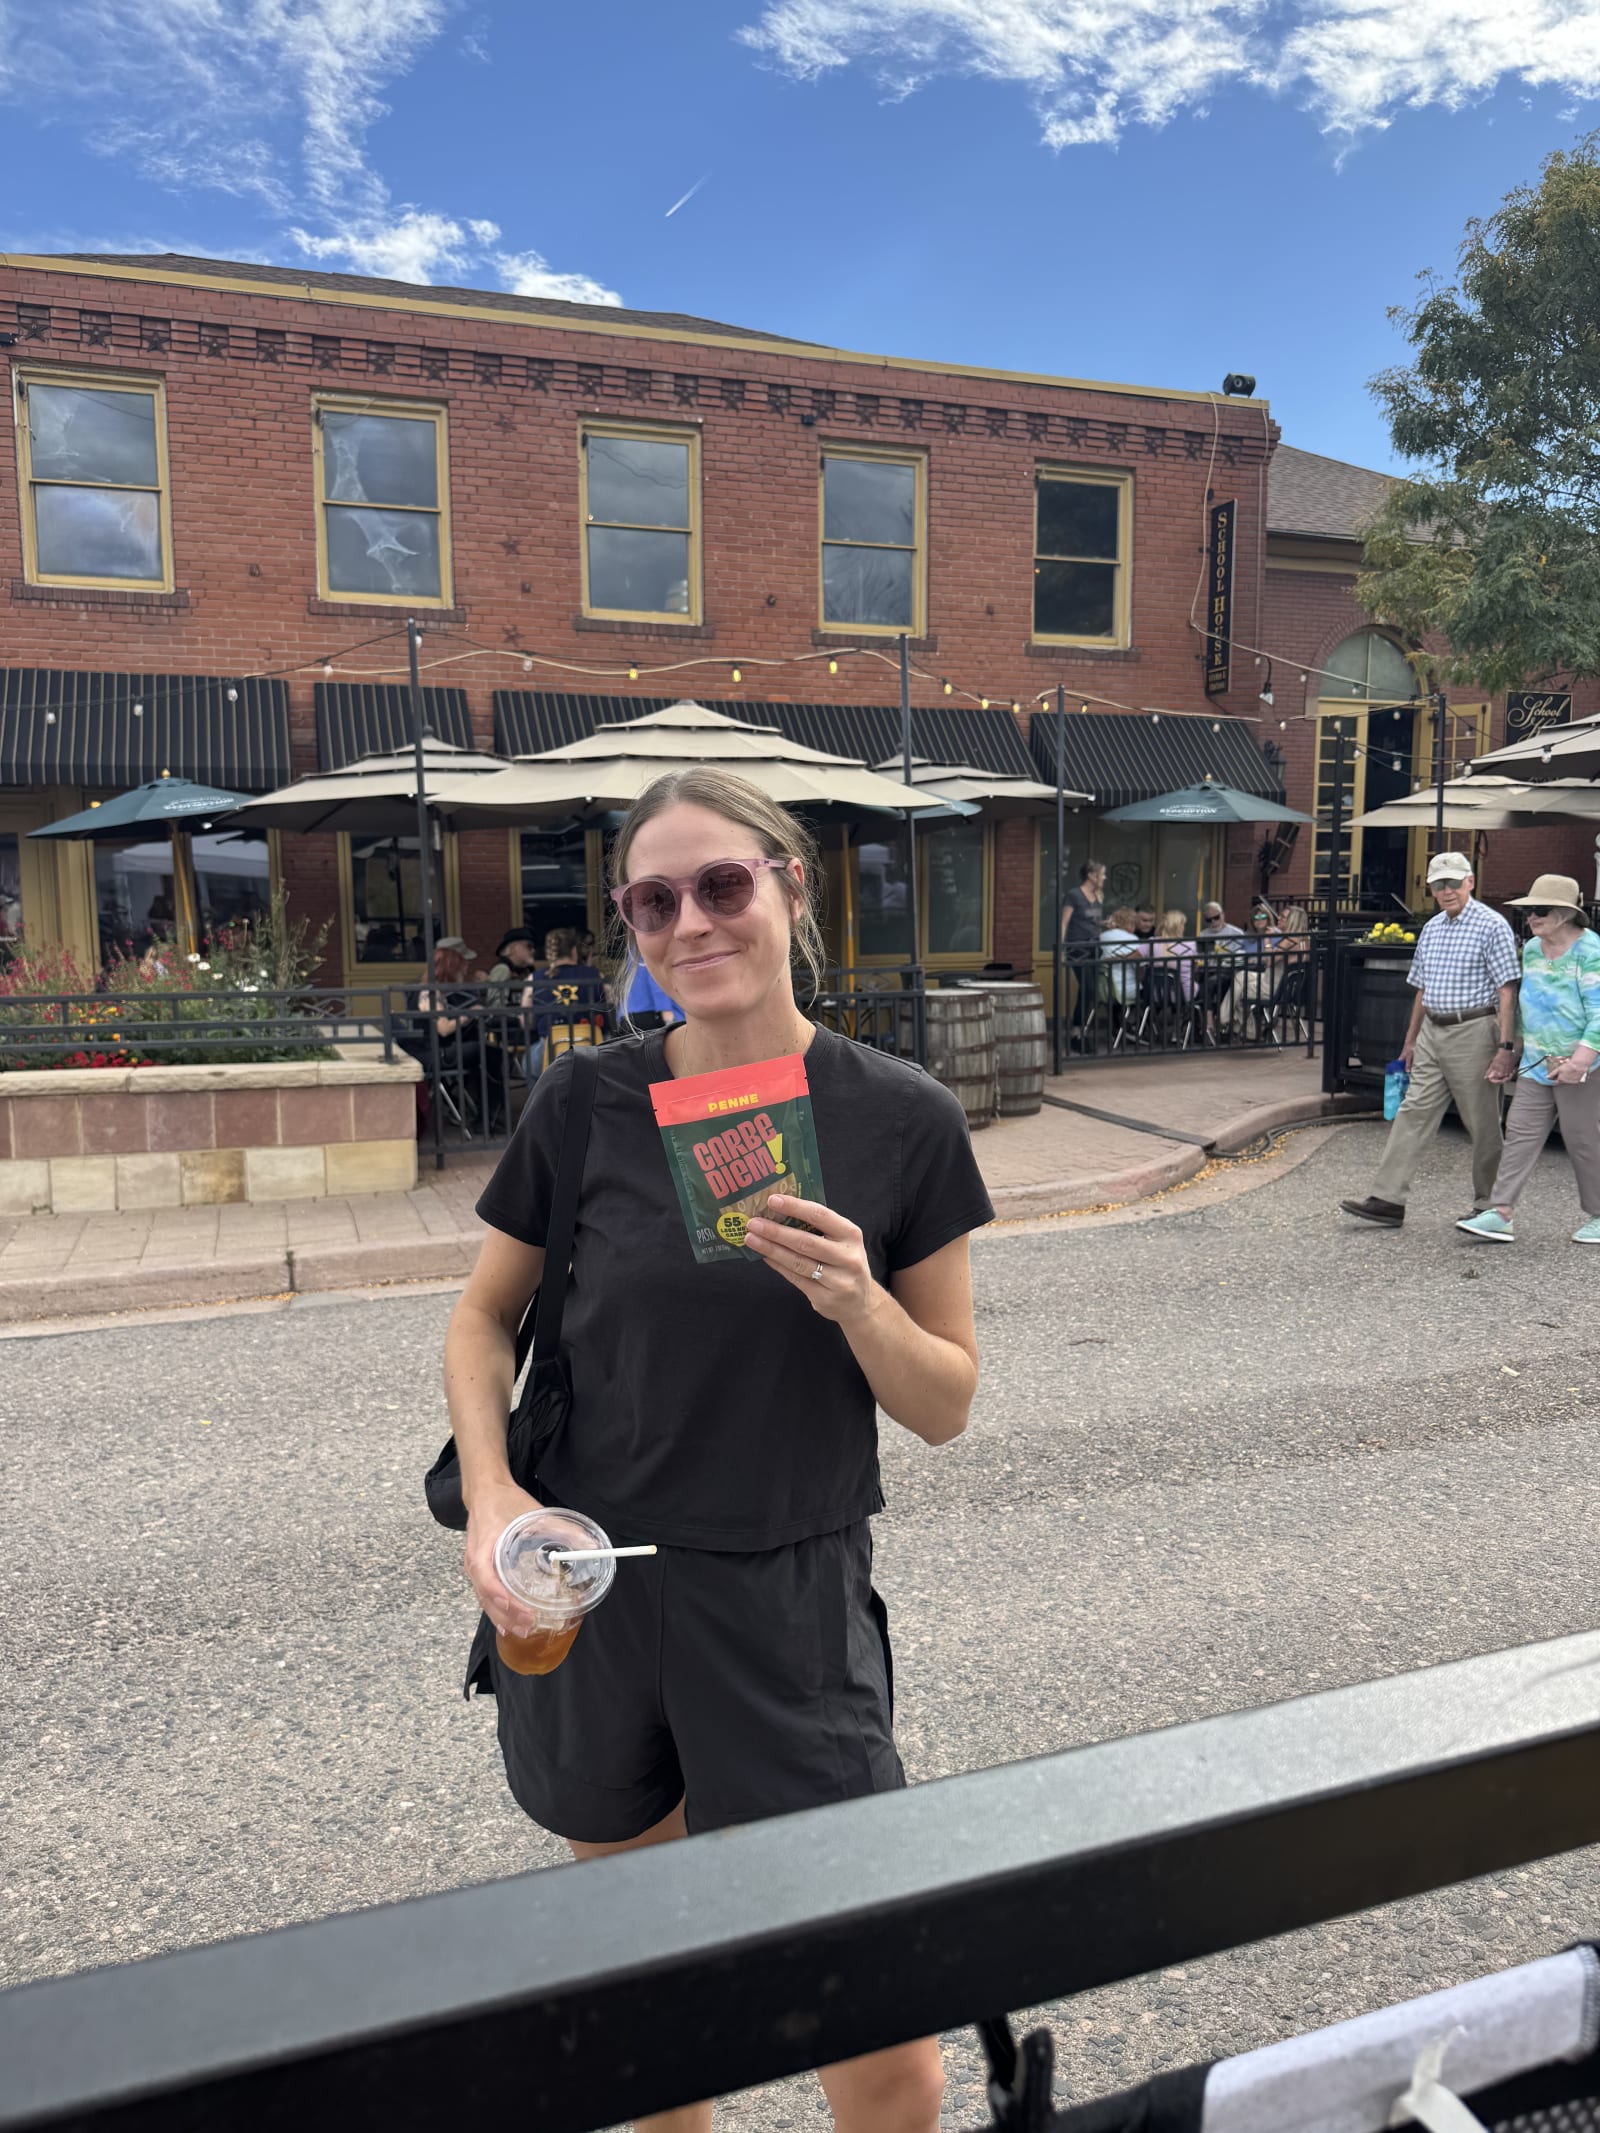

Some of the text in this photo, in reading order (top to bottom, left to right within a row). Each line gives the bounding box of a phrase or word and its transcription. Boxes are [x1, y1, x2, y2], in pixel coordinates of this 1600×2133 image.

[1215, 512, 1228, 592] SCHOOL
[1213, 597, 1225, 666] HOUSE
[1507, 695, 1570, 728] School
[708, 1094, 759, 1113] PENNE
[696, 1228, 716, 1244] PASTA
